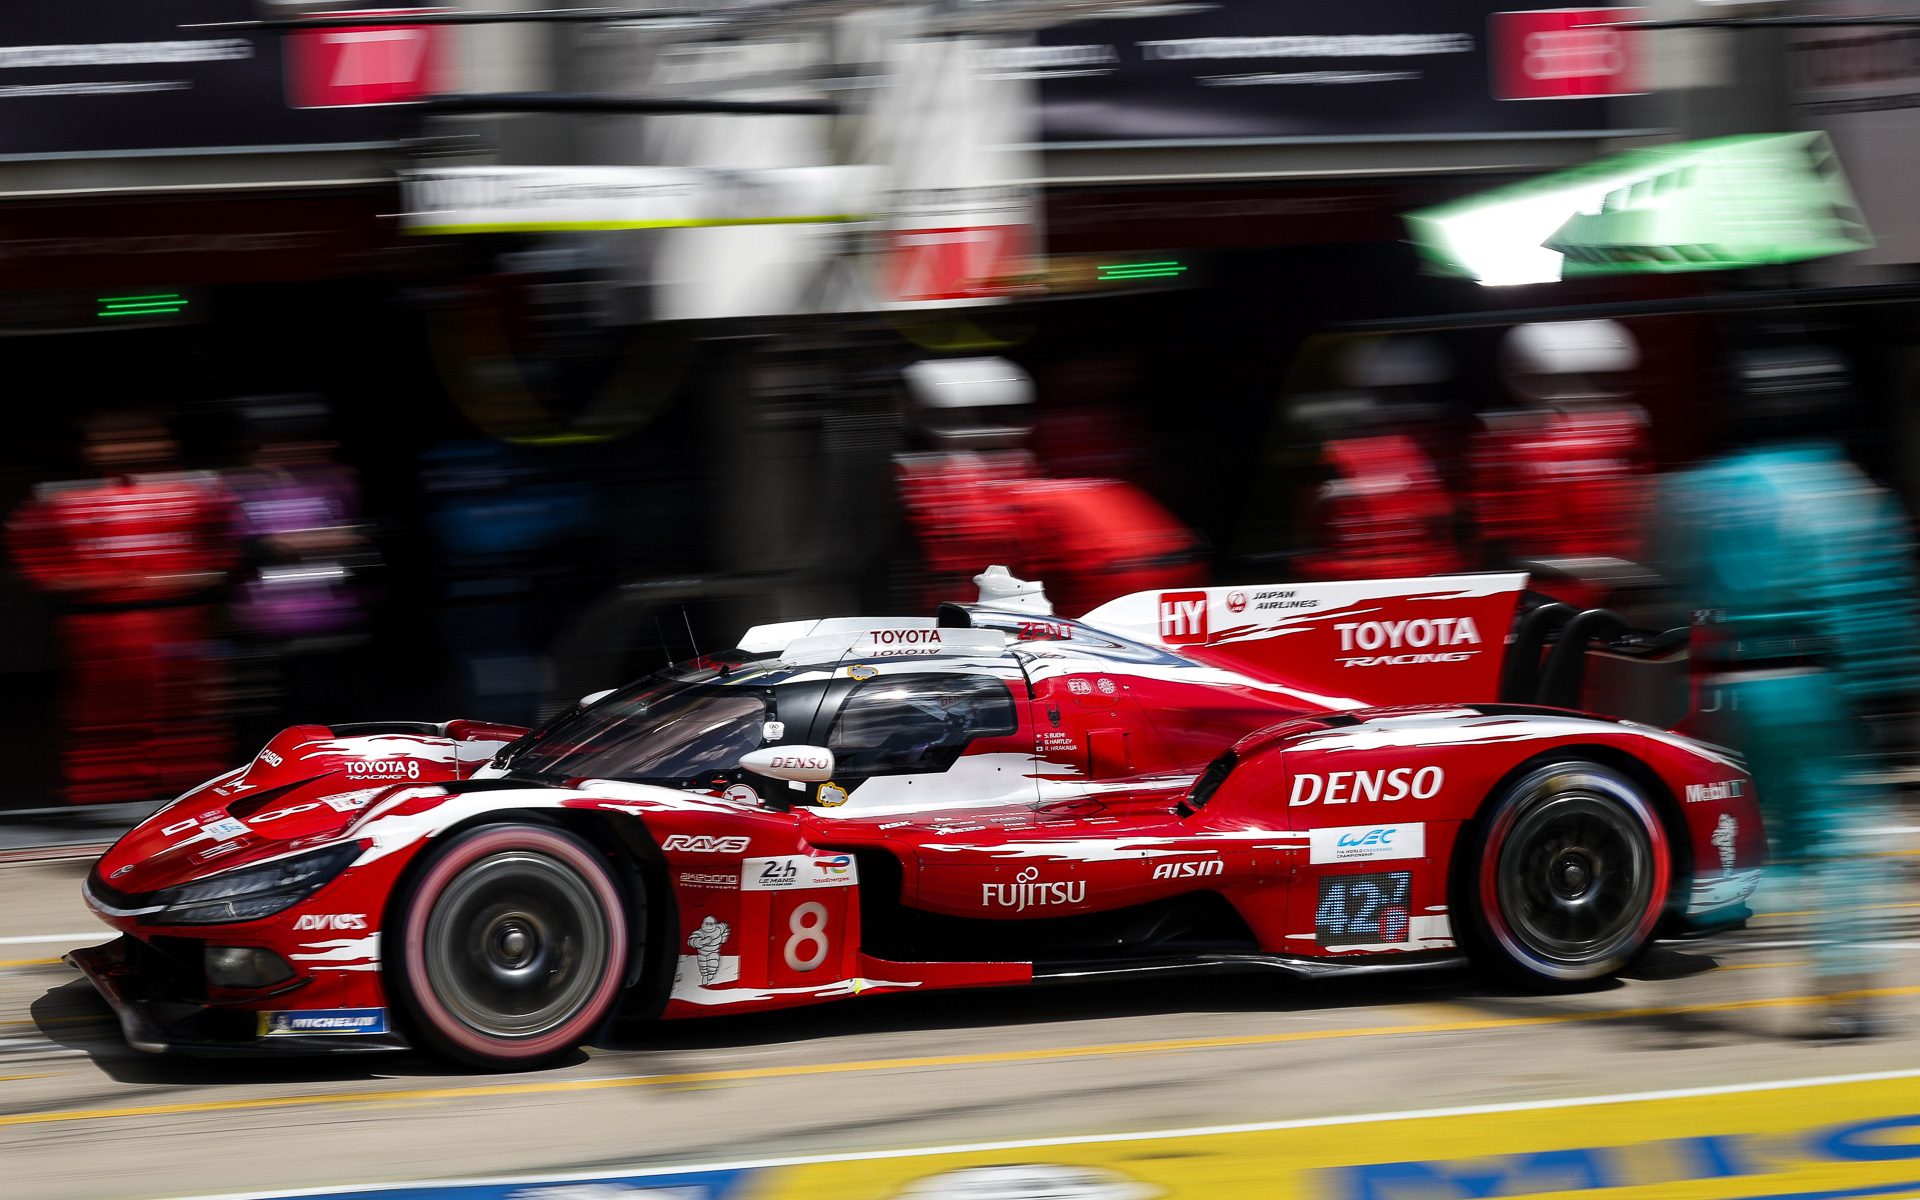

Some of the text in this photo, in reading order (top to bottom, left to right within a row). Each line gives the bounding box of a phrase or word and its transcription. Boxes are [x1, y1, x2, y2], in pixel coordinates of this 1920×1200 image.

[1252, 590, 1296, 600] JAPAN
[1255, 599, 1318, 610] AIRLINES
[1161, 600, 1206, 636] HY
[870, 629, 942, 644] TOYOTA
[1016, 621, 1075, 641] ZENT
[1334, 616, 1482, 650] TOYOTA
[1334, 651, 1482, 667] RACING
[259, 749, 283, 767] CASIO
[770, 757, 828, 769] DENSO
[344, 760, 420, 779] TOYOTA 8
[1289, 766, 1445, 807] DENSO
[1685, 783, 1728, 803] Mobil
[878, 820, 913, 830] NSK
[661, 834, 752, 853] RAYS
[1337, 829, 1396, 847] WEC
[1152, 860, 1224, 879] AISIN
[982, 880, 1086, 912] FUJITSU
[784, 901, 829, 972] 8
[291, 1016, 378, 1029] MICHELIN
